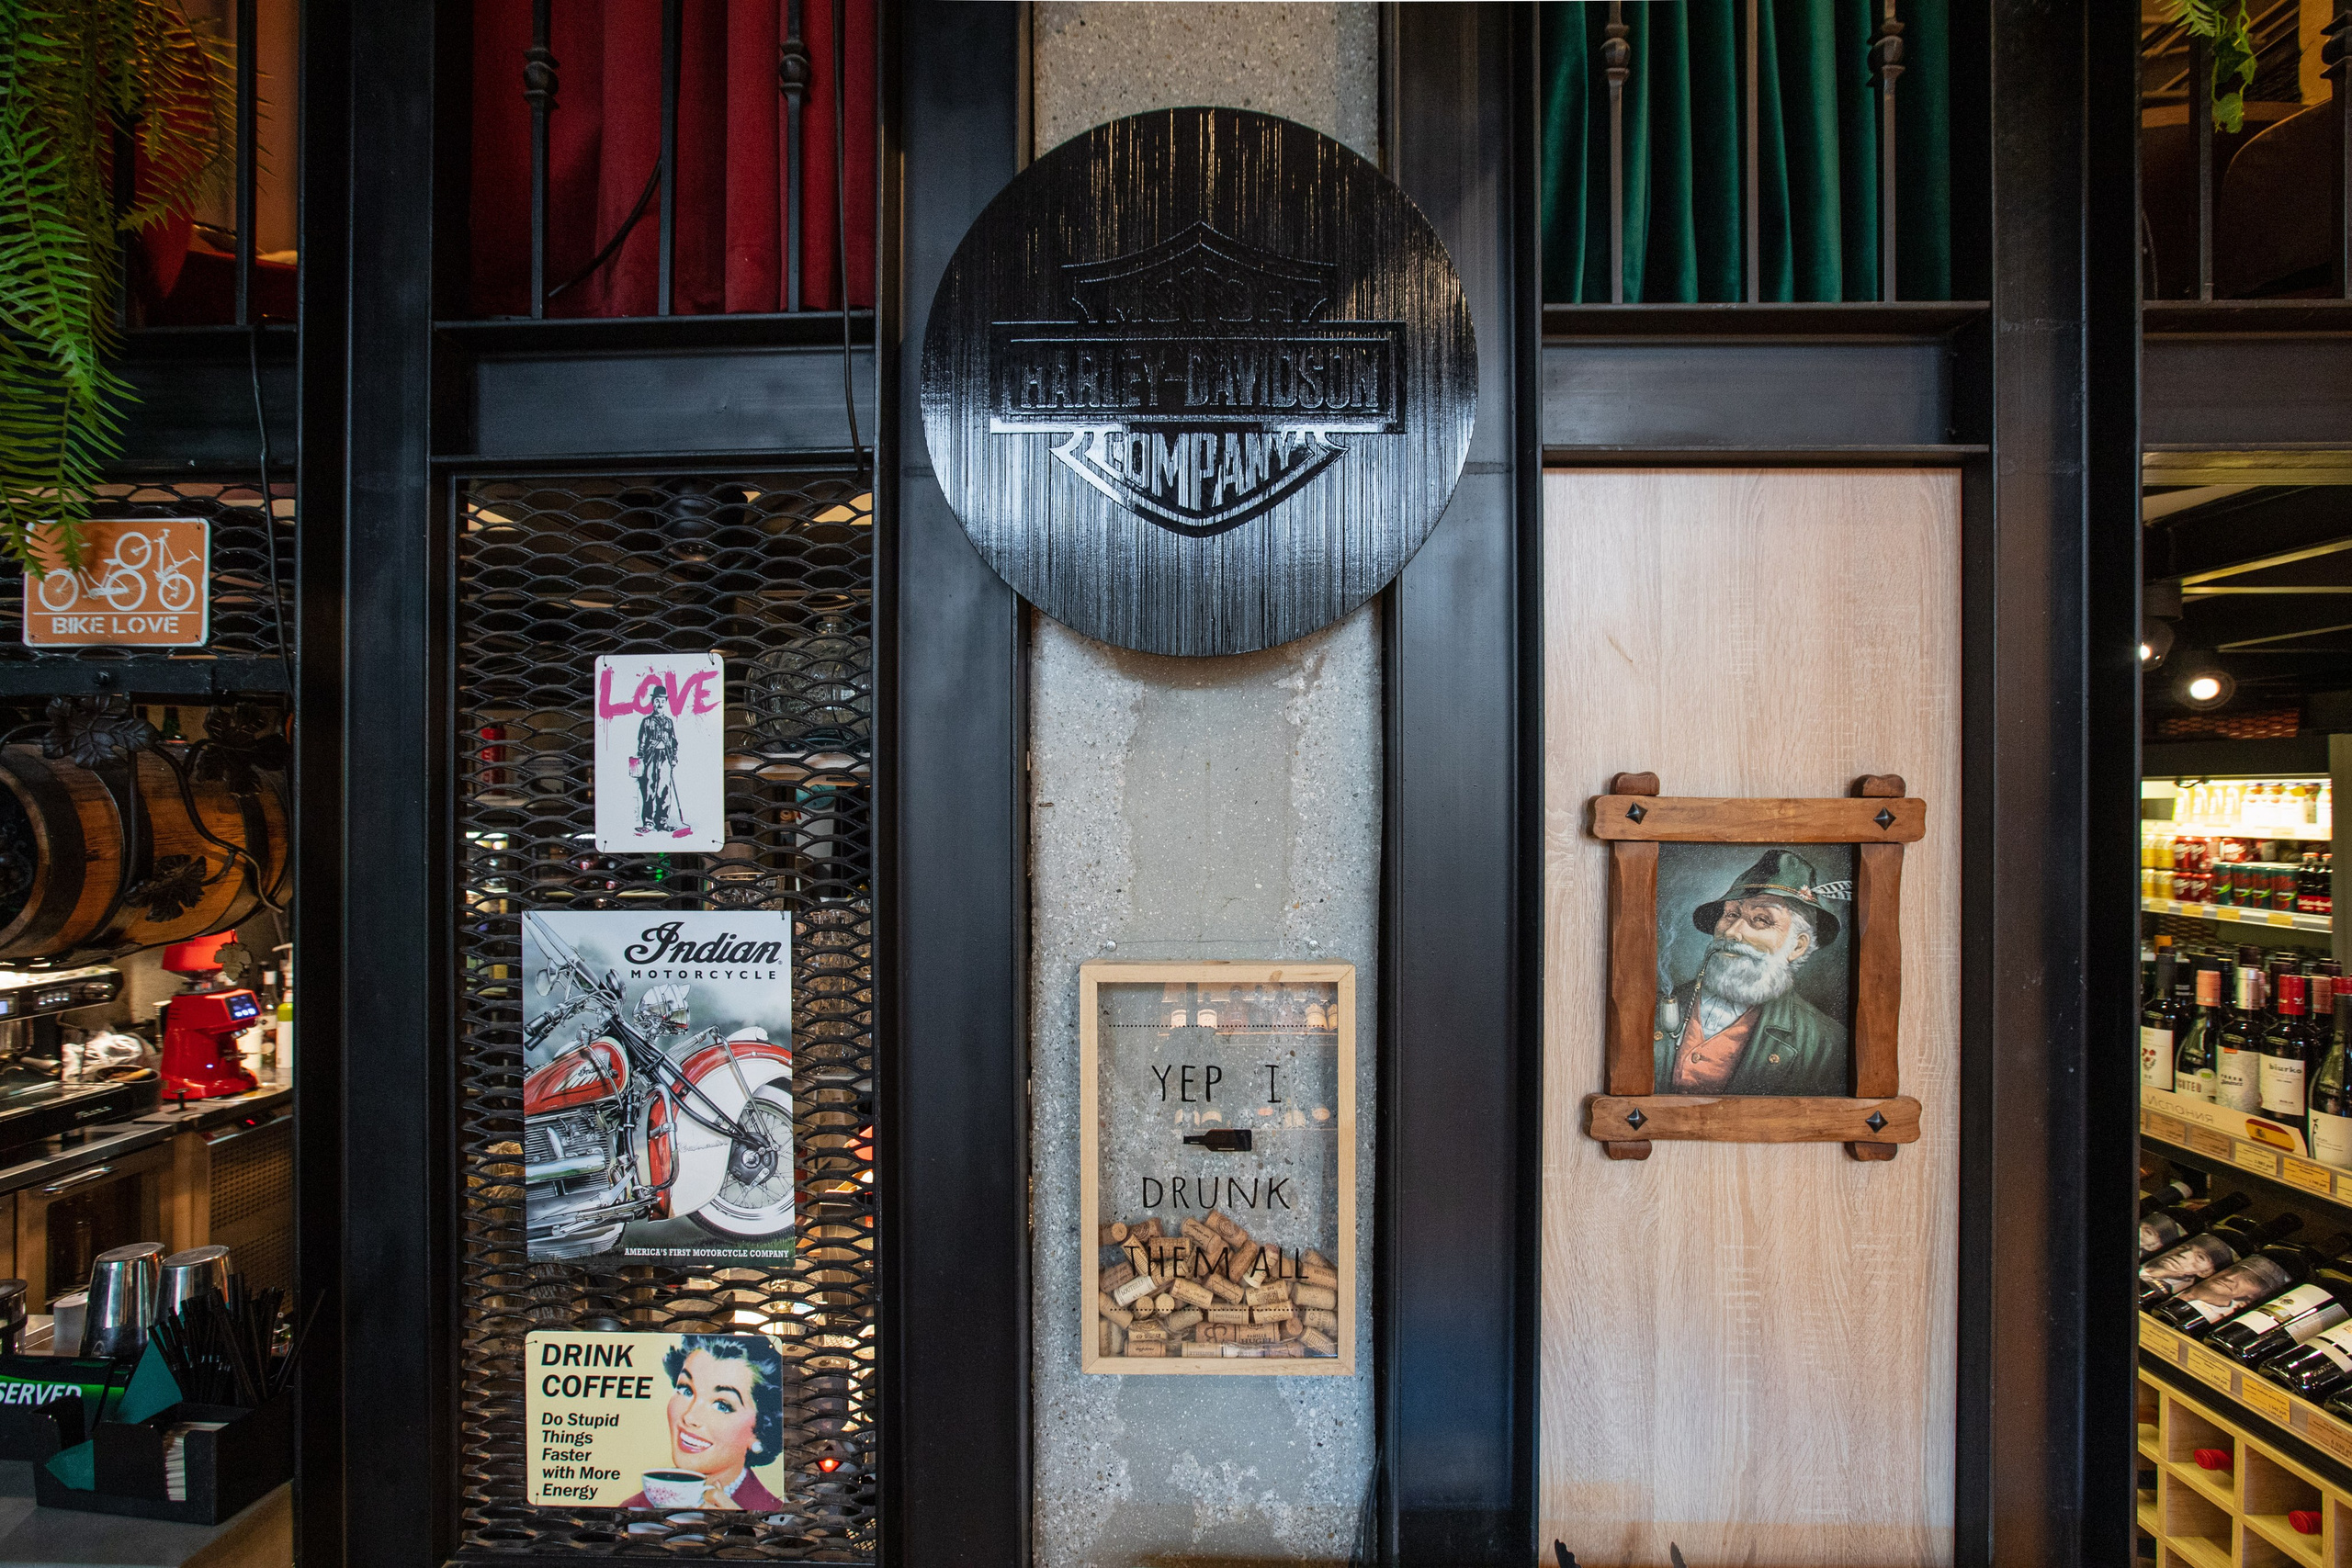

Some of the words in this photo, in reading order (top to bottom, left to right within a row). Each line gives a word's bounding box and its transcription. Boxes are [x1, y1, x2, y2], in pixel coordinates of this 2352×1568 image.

[1020, 346, 1380, 409] HARLEY-DAVIDSON
[1104, 432, 1297, 512] COMPANY
[52, 616, 105, 634] BIKE
[112, 616, 179, 634] LOVE
[598, 667, 722, 718] LOVE
[624, 921, 782, 964] Indian
[631, 970, 776, 980] MOTORCYCLE
[1151, 1064, 1224, 1103] YEP
[1265, 1064, 1283, 1104] I
[2144, 1093, 2214, 1124] Испания
[1141, 1177, 1292, 1210] DRUNK
[624, 1247, 668, 1257] AMERICA'S
[669, 1248, 691, 1257] FIRST
[692, 1248, 748, 1258] MOTORCYCLE
[749, 1249, 789, 1258] COMPANY
[1123, 1246, 1231, 1280] THEM
[1250, 1246, 1310, 1280] ALL
[541, 1343, 635, 1368] DRINK
[542, 1374, 654, 1399] COFFEE
[542, 1413, 563, 1426] Do
[568, 1413, 619, 1428] Stupid
[542, 1430, 594, 1447] Things
[542, 1448, 592, 1461] Faster
[542, 1466, 575, 1479] with
[580, 1467, 620, 1480] More
[542, 1483, 598, 1500] Energy
